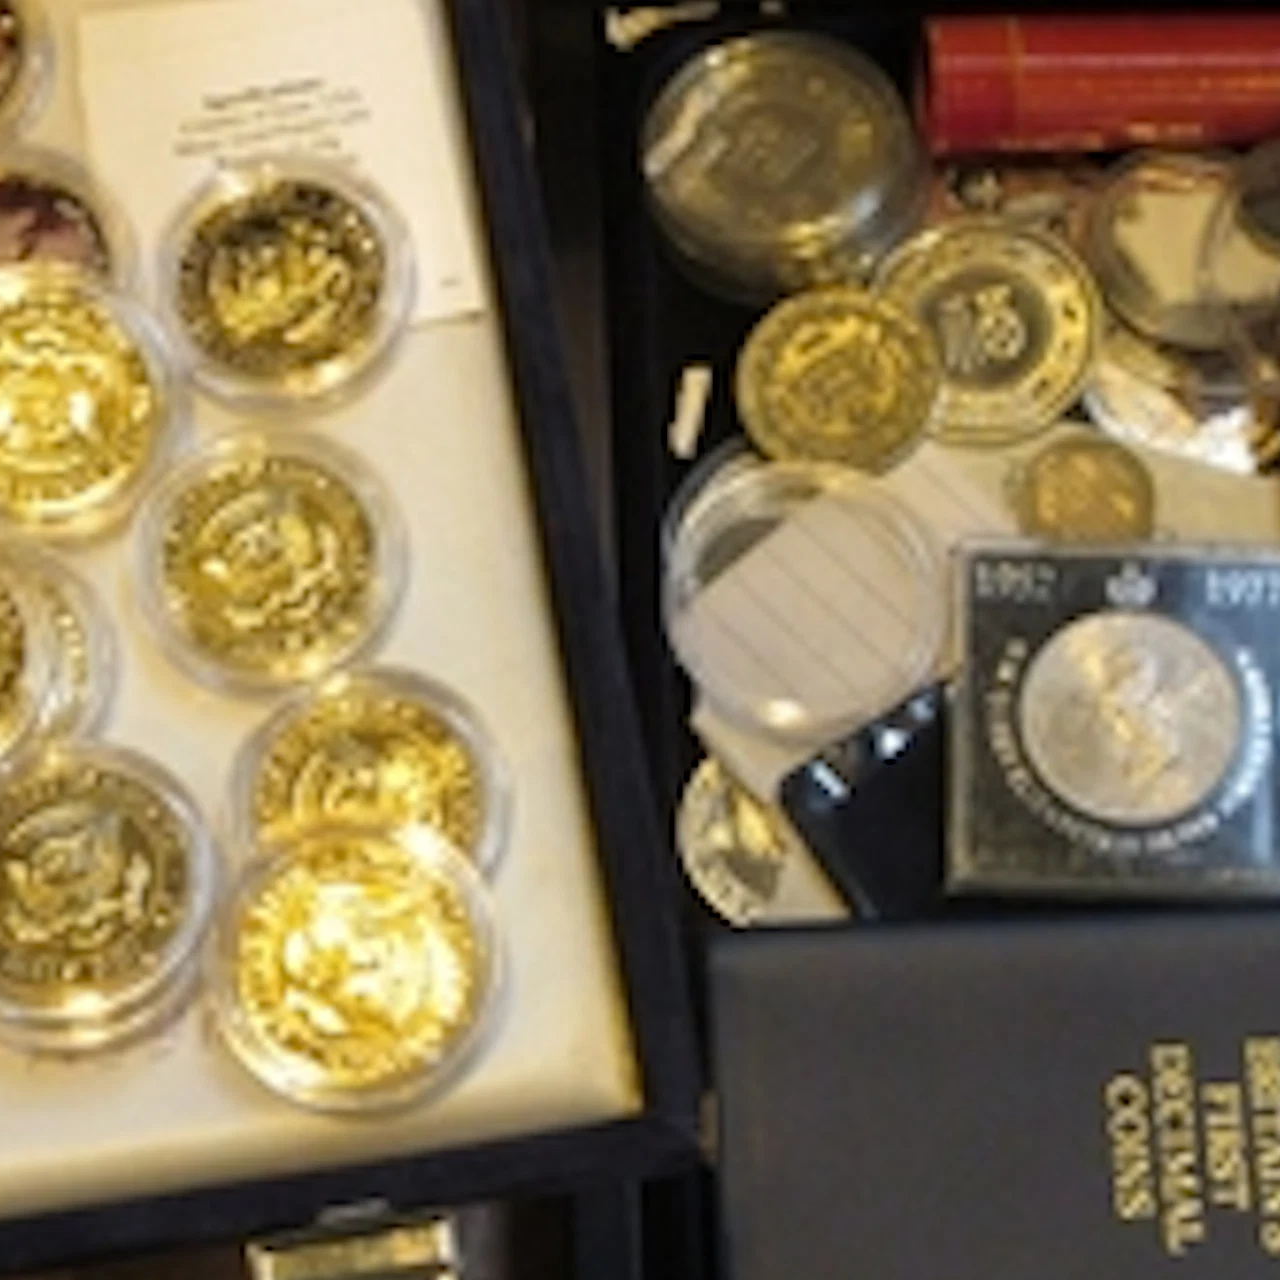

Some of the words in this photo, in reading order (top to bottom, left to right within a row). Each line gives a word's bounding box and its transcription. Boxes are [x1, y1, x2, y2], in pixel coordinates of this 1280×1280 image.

[1104, 1072, 1157, 1220] COINS
[1149, 1041, 1207, 1257] DECIMAL
[1200, 1080, 1251, 1212] FIRST
